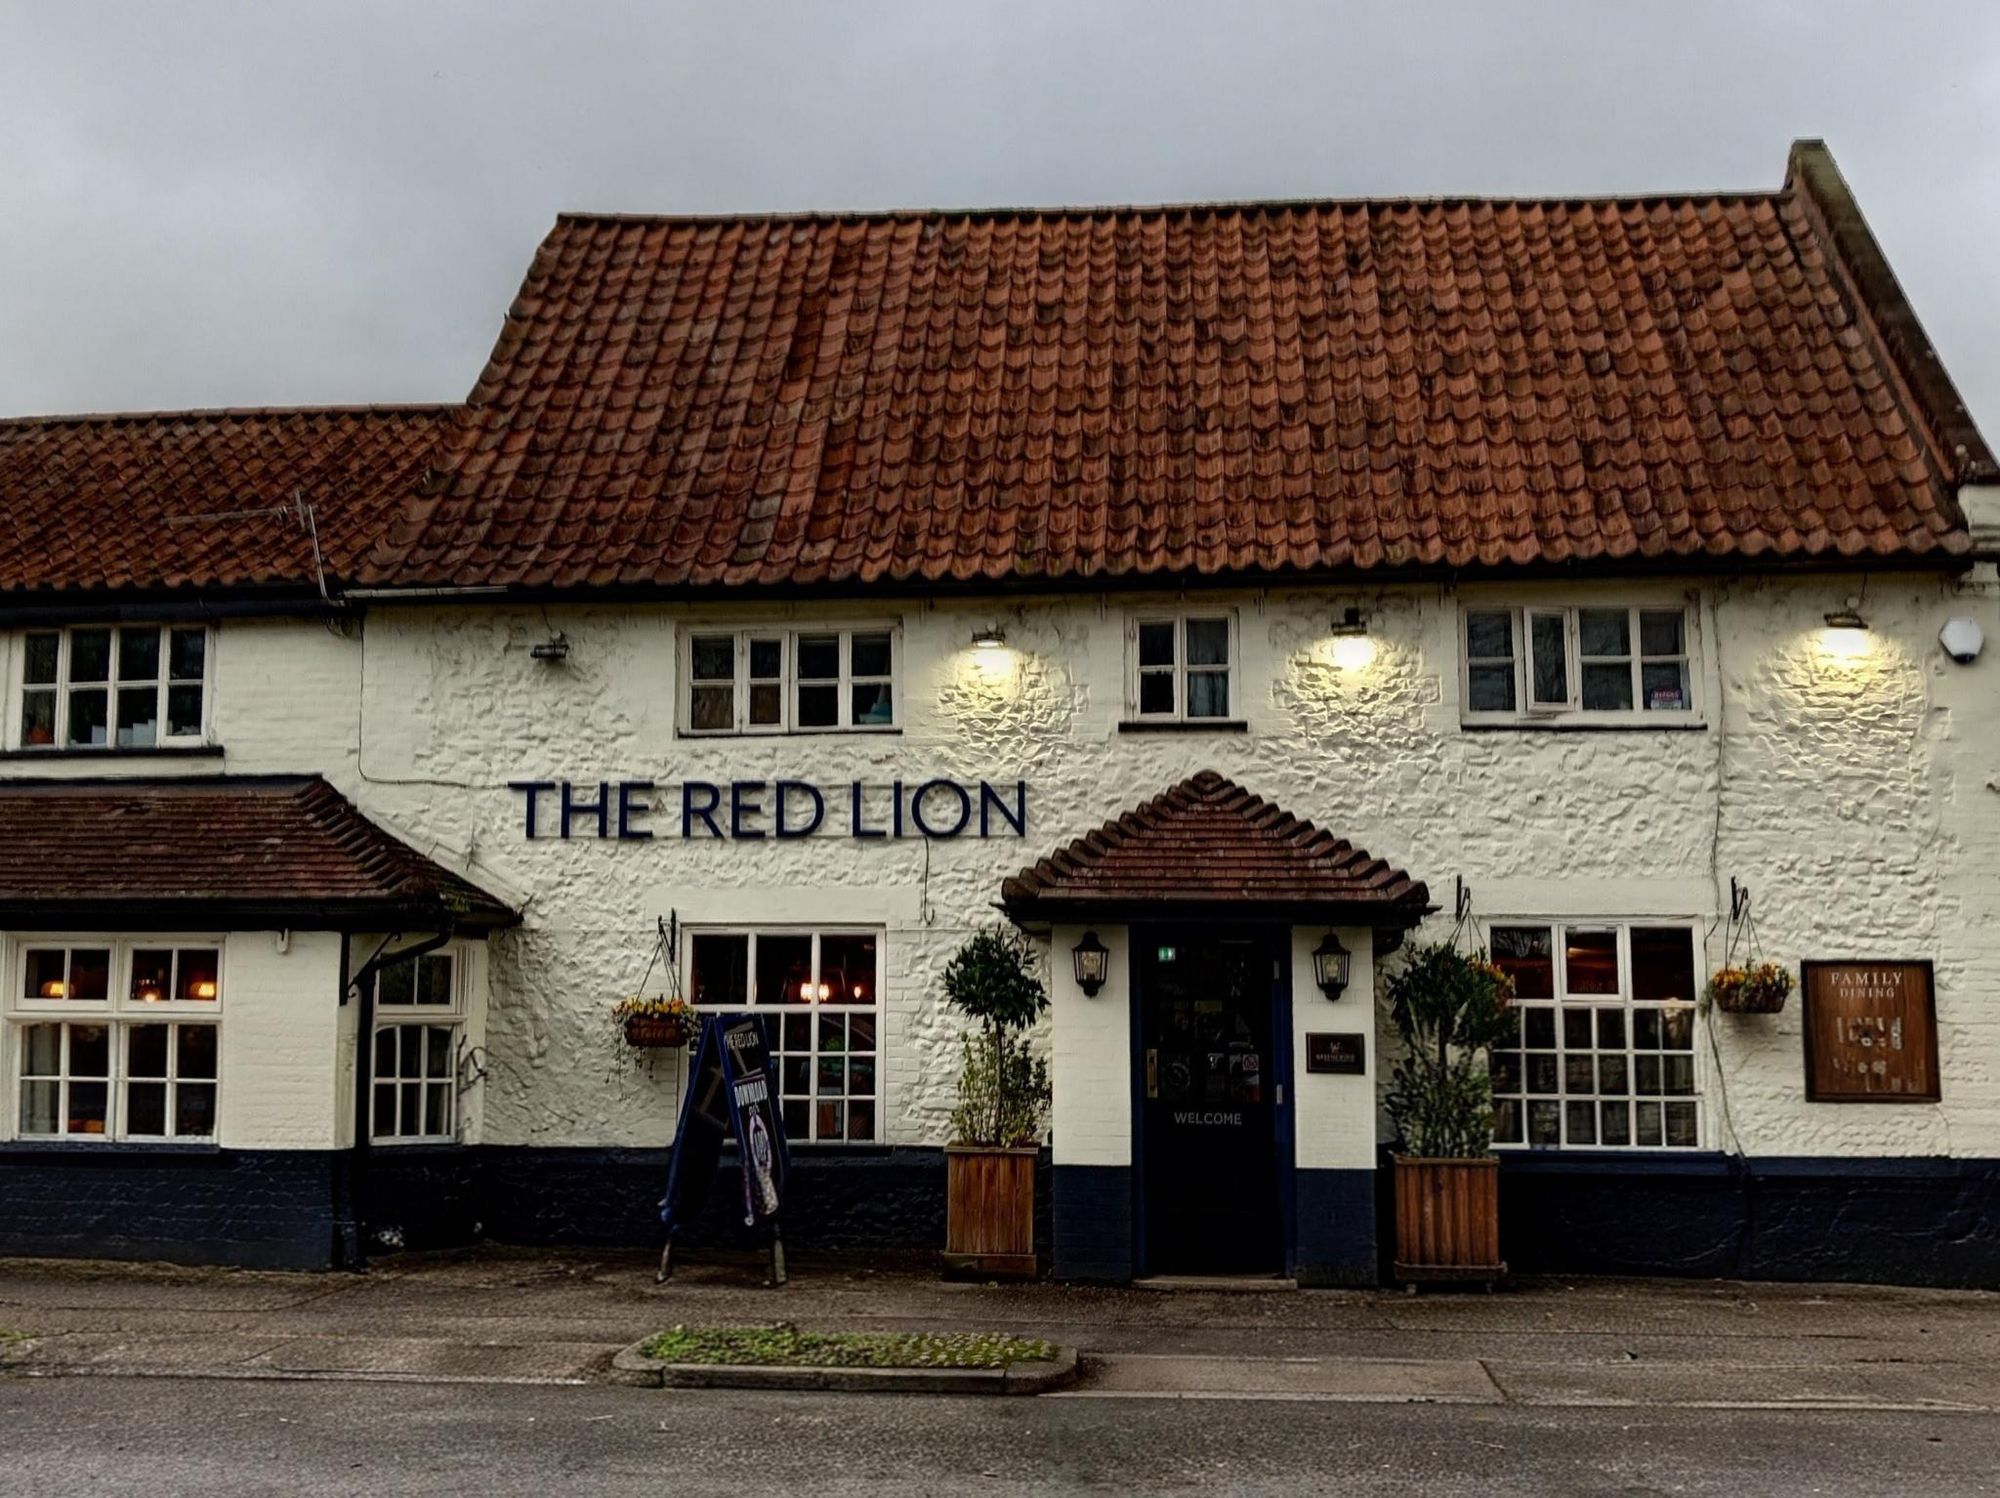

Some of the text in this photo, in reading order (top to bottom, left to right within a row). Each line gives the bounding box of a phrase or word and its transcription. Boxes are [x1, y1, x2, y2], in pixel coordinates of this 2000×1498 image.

[508, 778, 1026, 839] THE RED LION
[1831, 972, 1902, 985] FAMILY
[1840, 987, 1895, 999] DINING
[1174, 1112, 1242, 1125] WELCOME
